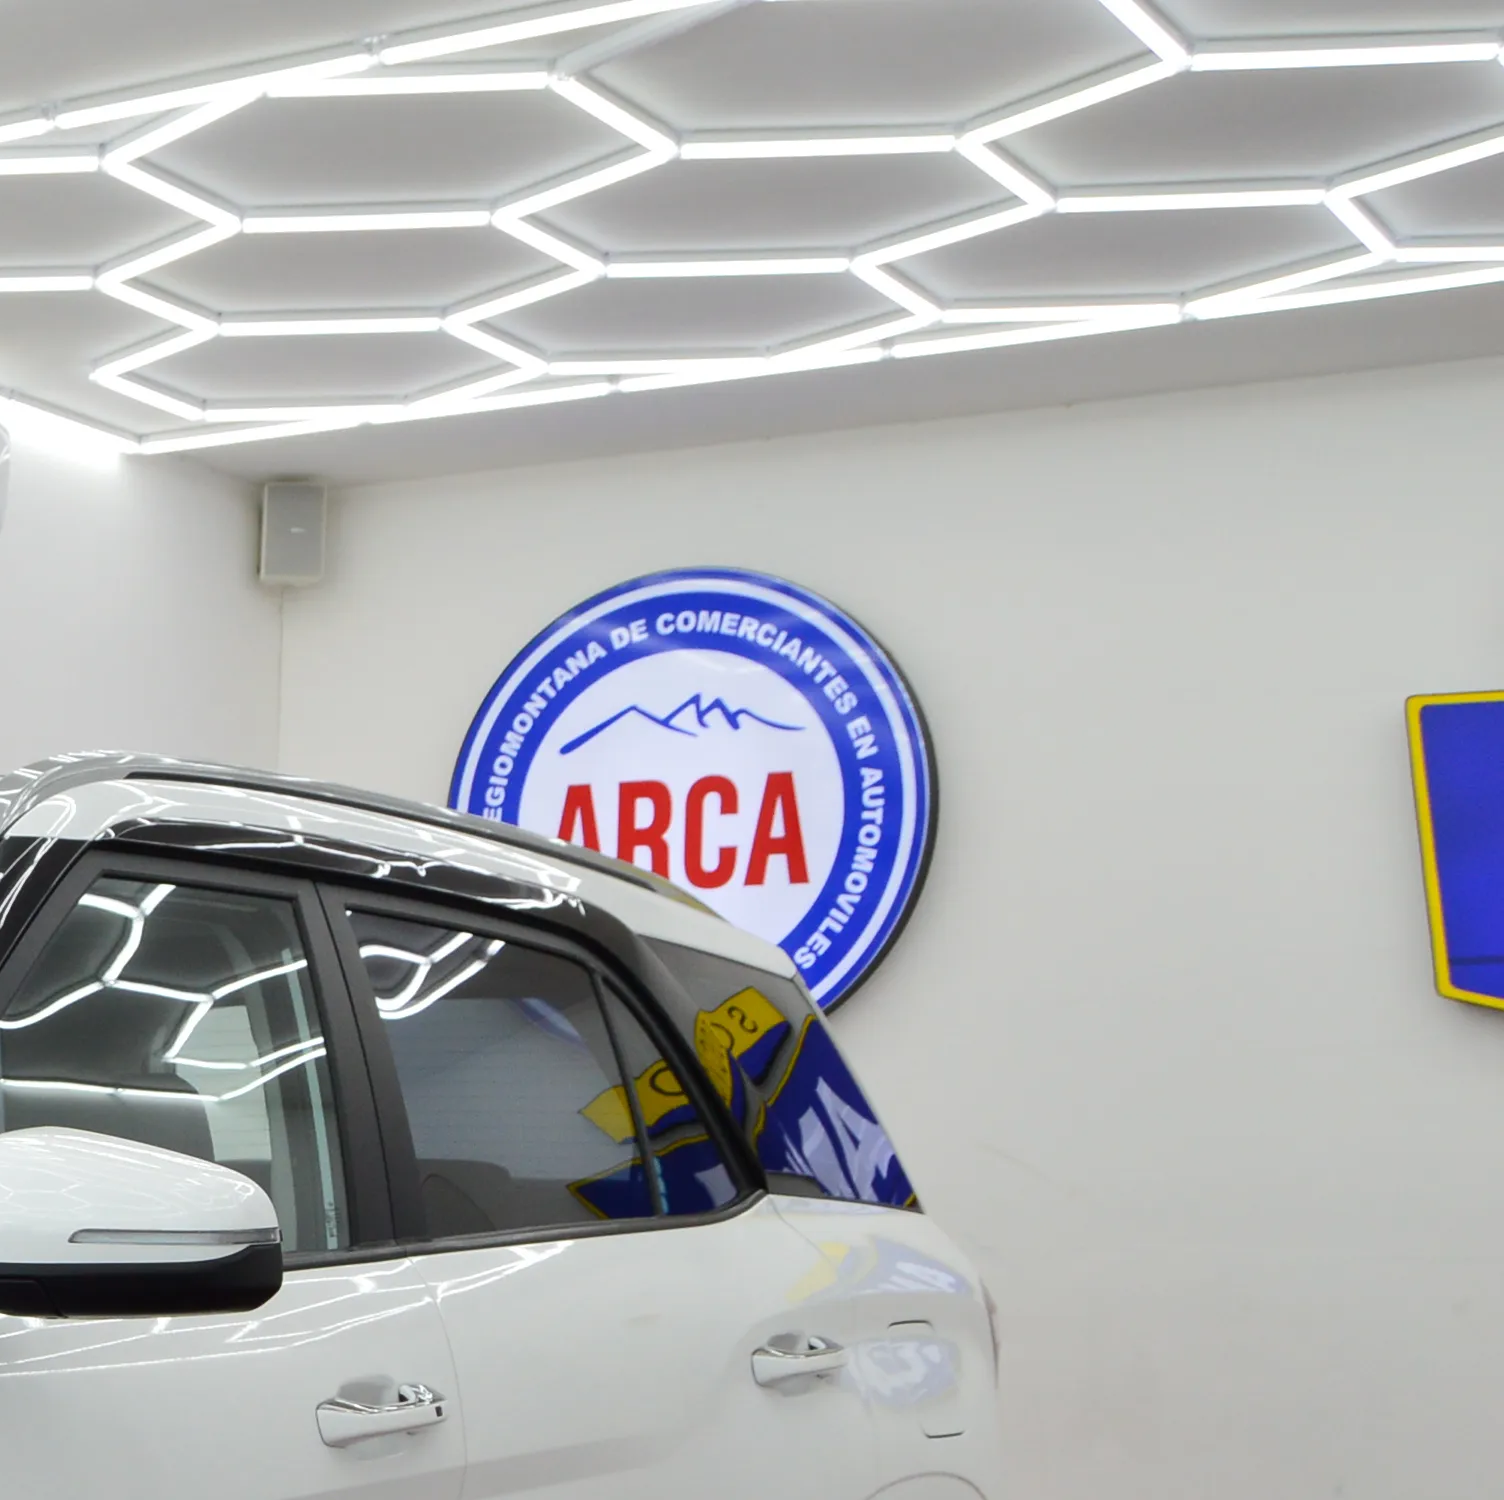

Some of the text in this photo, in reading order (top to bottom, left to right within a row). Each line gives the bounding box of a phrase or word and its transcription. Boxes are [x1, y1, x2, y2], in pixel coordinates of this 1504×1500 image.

[482, 609, 886, 971] EGIOMONTANA DE COMERCIANTES EN AUTOMOVILES
[556, 770, 810, 890] ARCA
